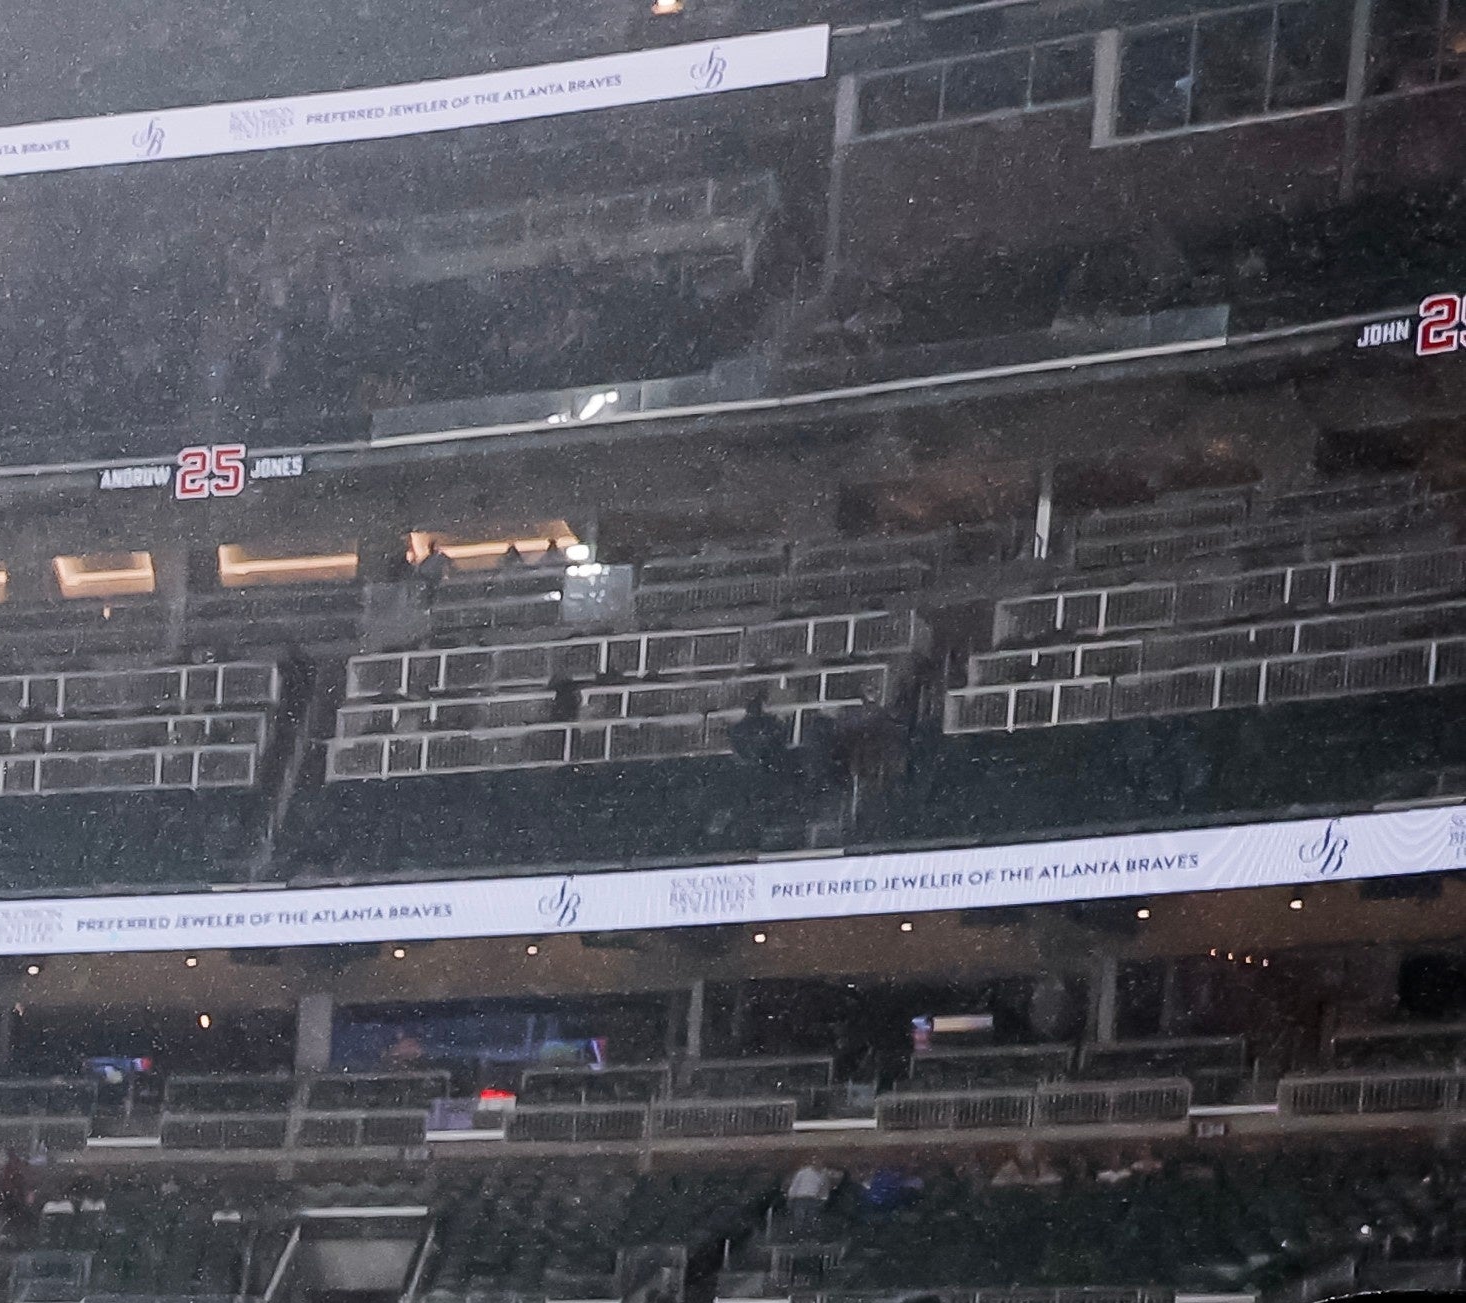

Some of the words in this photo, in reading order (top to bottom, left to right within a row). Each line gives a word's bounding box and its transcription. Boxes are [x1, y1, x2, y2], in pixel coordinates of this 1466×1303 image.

[1357, 318, 1410, 347] JOHN
[175, 443, 247, 499] 25
[250, 455, 303, 478] JONES
[770, 876, 878, 899] PREFERRED
[882, 870, 963, 891] JEWELER
[967, 868, 994, 885] OF
[999, 865, 1034, 882] THE
[1037, 858, 1121, 880] ATLANTA
[1125, 852, 1200, 873] BRAVES
[248, 910, 270, 926] OF
[277, 909, 309, 924] THE
